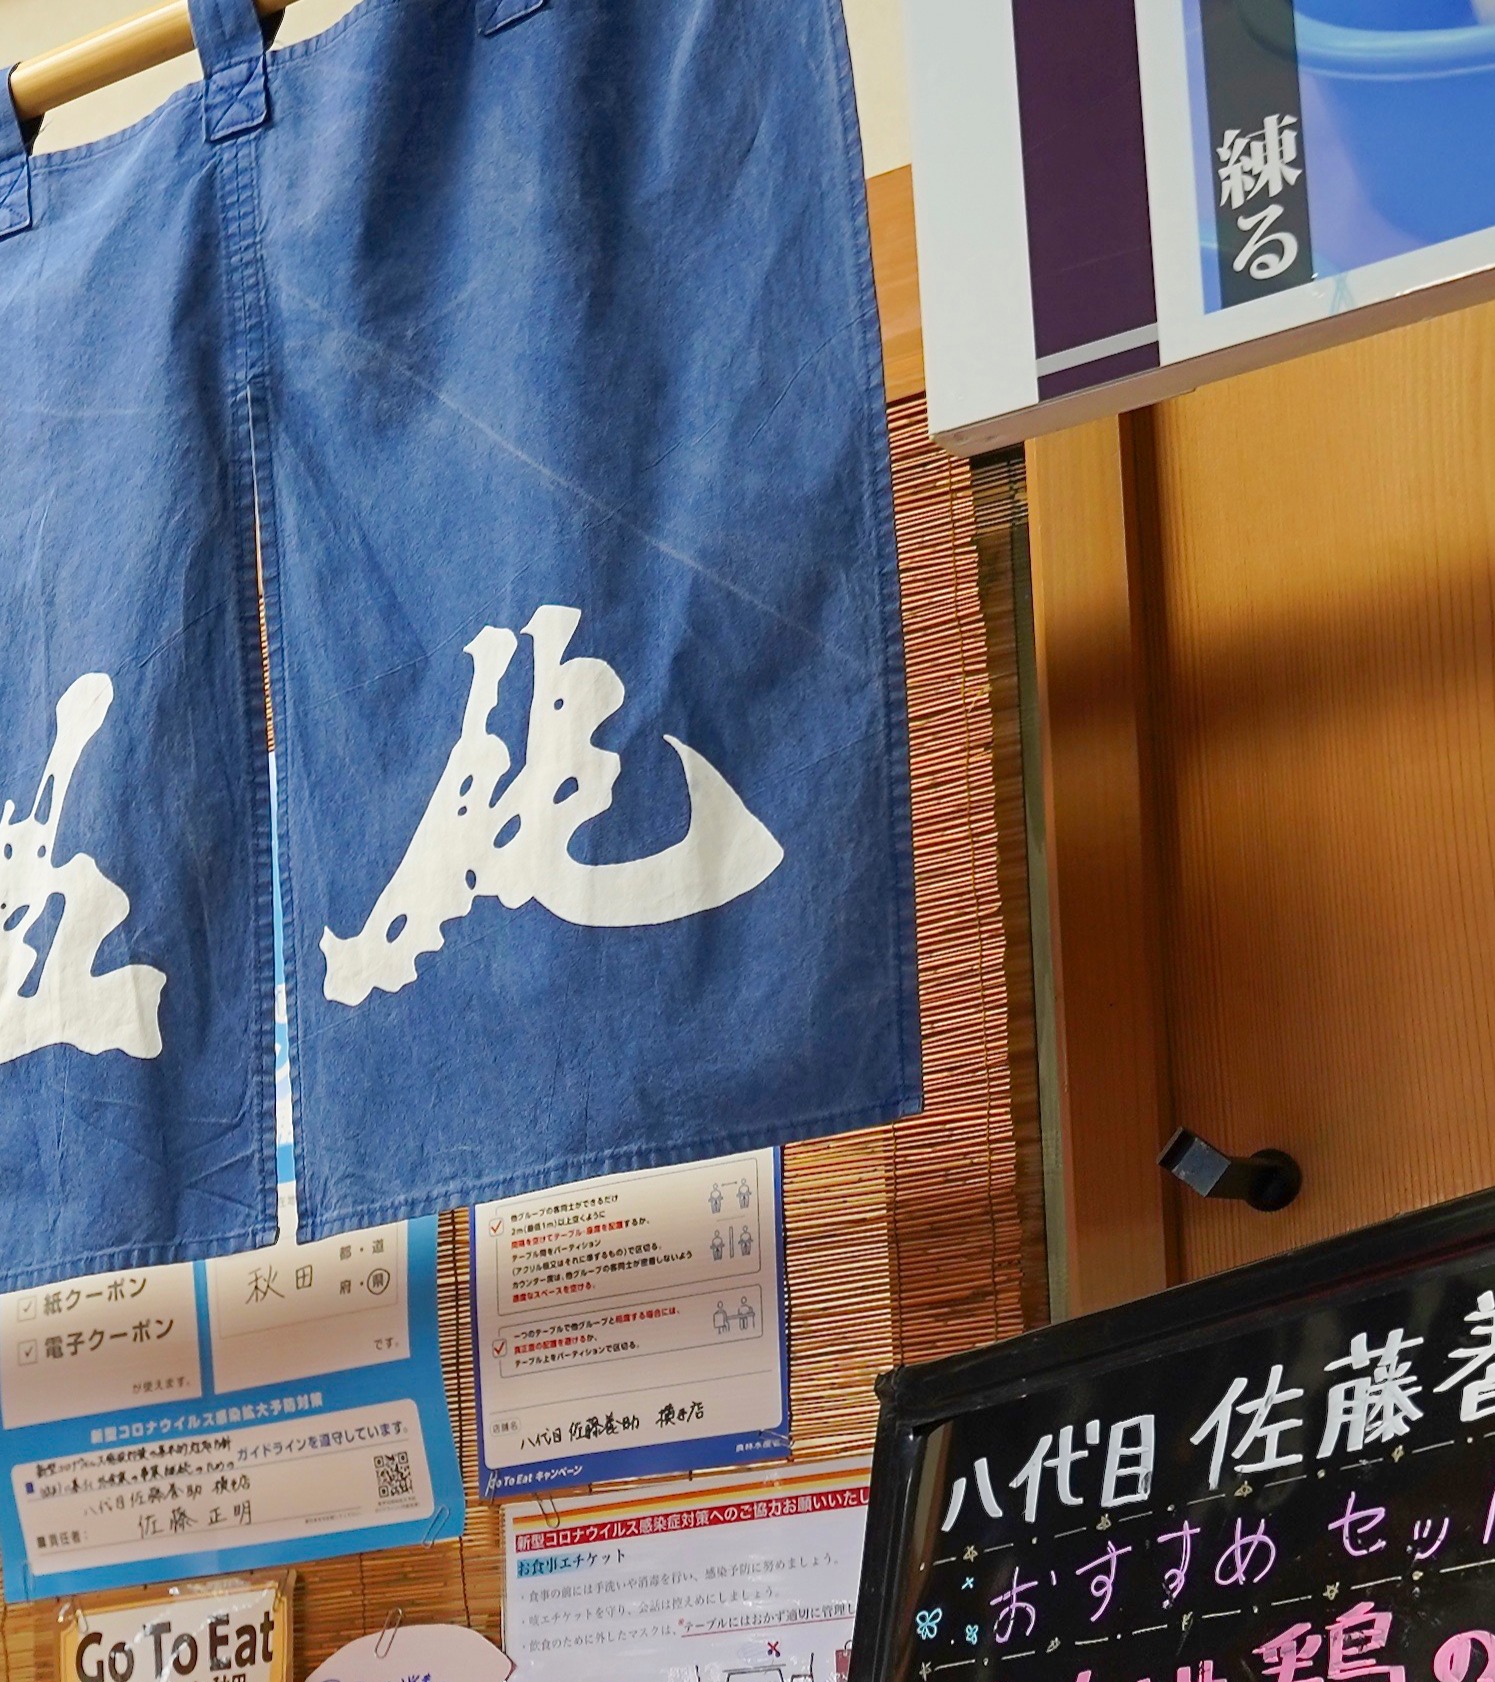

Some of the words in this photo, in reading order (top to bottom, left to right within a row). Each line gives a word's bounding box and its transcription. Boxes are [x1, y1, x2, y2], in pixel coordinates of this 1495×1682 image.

[1218, 113, 1303, 280] 練る
[43, 1276, 148, 1316] 紙クーポン
[246, 1264, 314, 1304] 秋田
[44, 1318, 175, 1361] 電子クーポン
[373, 1337, 402, 1351] です。
[132, 1378, 192, 1395] が使えます。
[237, 1420, 409, 1462] ガイドラインを遵守しています。
[520, 1428, 561, 1450] 八代目
[656, 1401, 704, 1428] 横手店
[504, 1475, 515, 1487] To
[516, 1473, 532, 1485] Eat
[535, 1465, 583, 1482] キャンペーン
[941, 1413, 1155, 1532] 八代目
[516, 1488, 869, 1551] 新型コロナウイルス感染症対策へのご協力お願いいたし
[517, 1549, 625, 1577] お食事エチケット
[990, 1515, 1276, 1645] おすすめ
[150, 1620, 198, 1678] To
[209, 1611, 275, 1672] Eat
